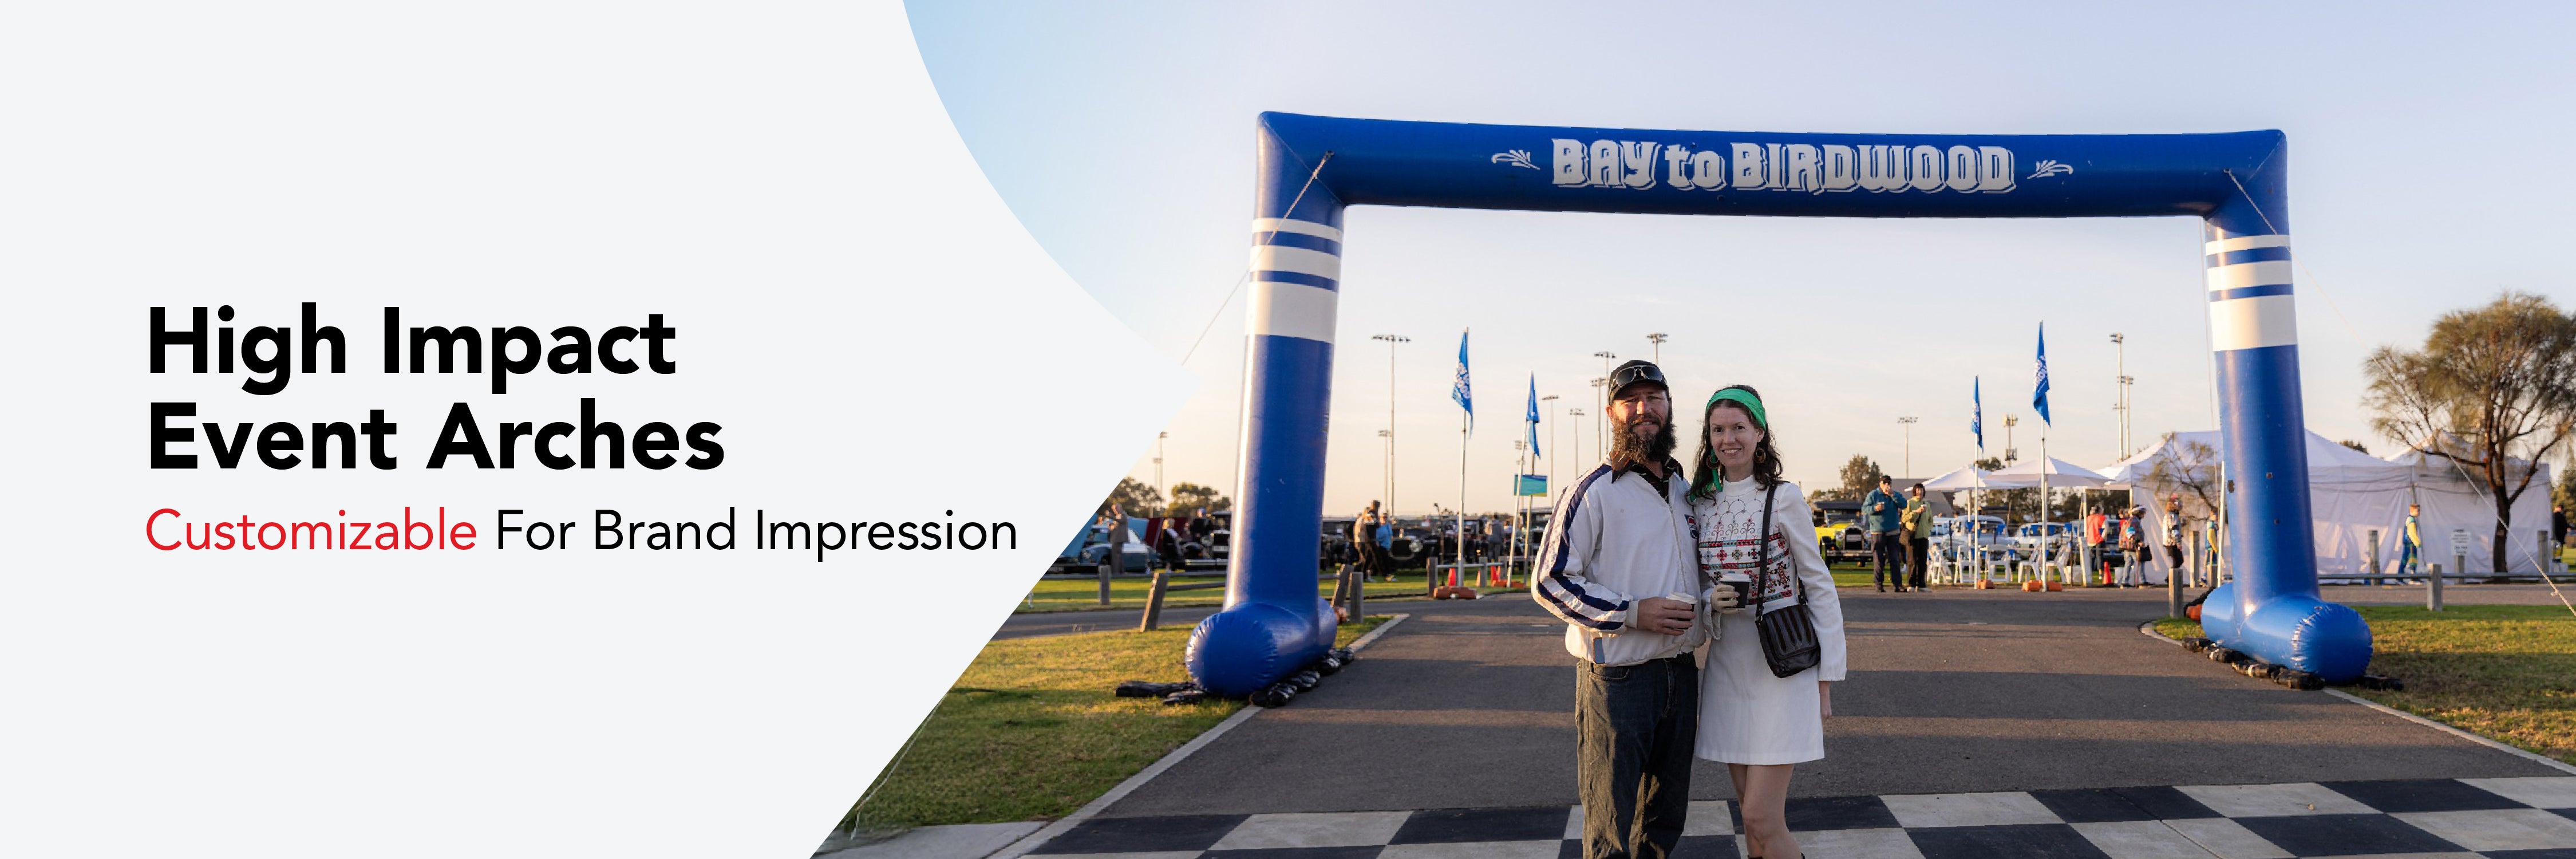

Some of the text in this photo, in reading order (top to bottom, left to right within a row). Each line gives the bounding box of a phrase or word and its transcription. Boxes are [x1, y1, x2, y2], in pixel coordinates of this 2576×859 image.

[1551, 139, 2017, 195] BAY to BIRDWOOD
